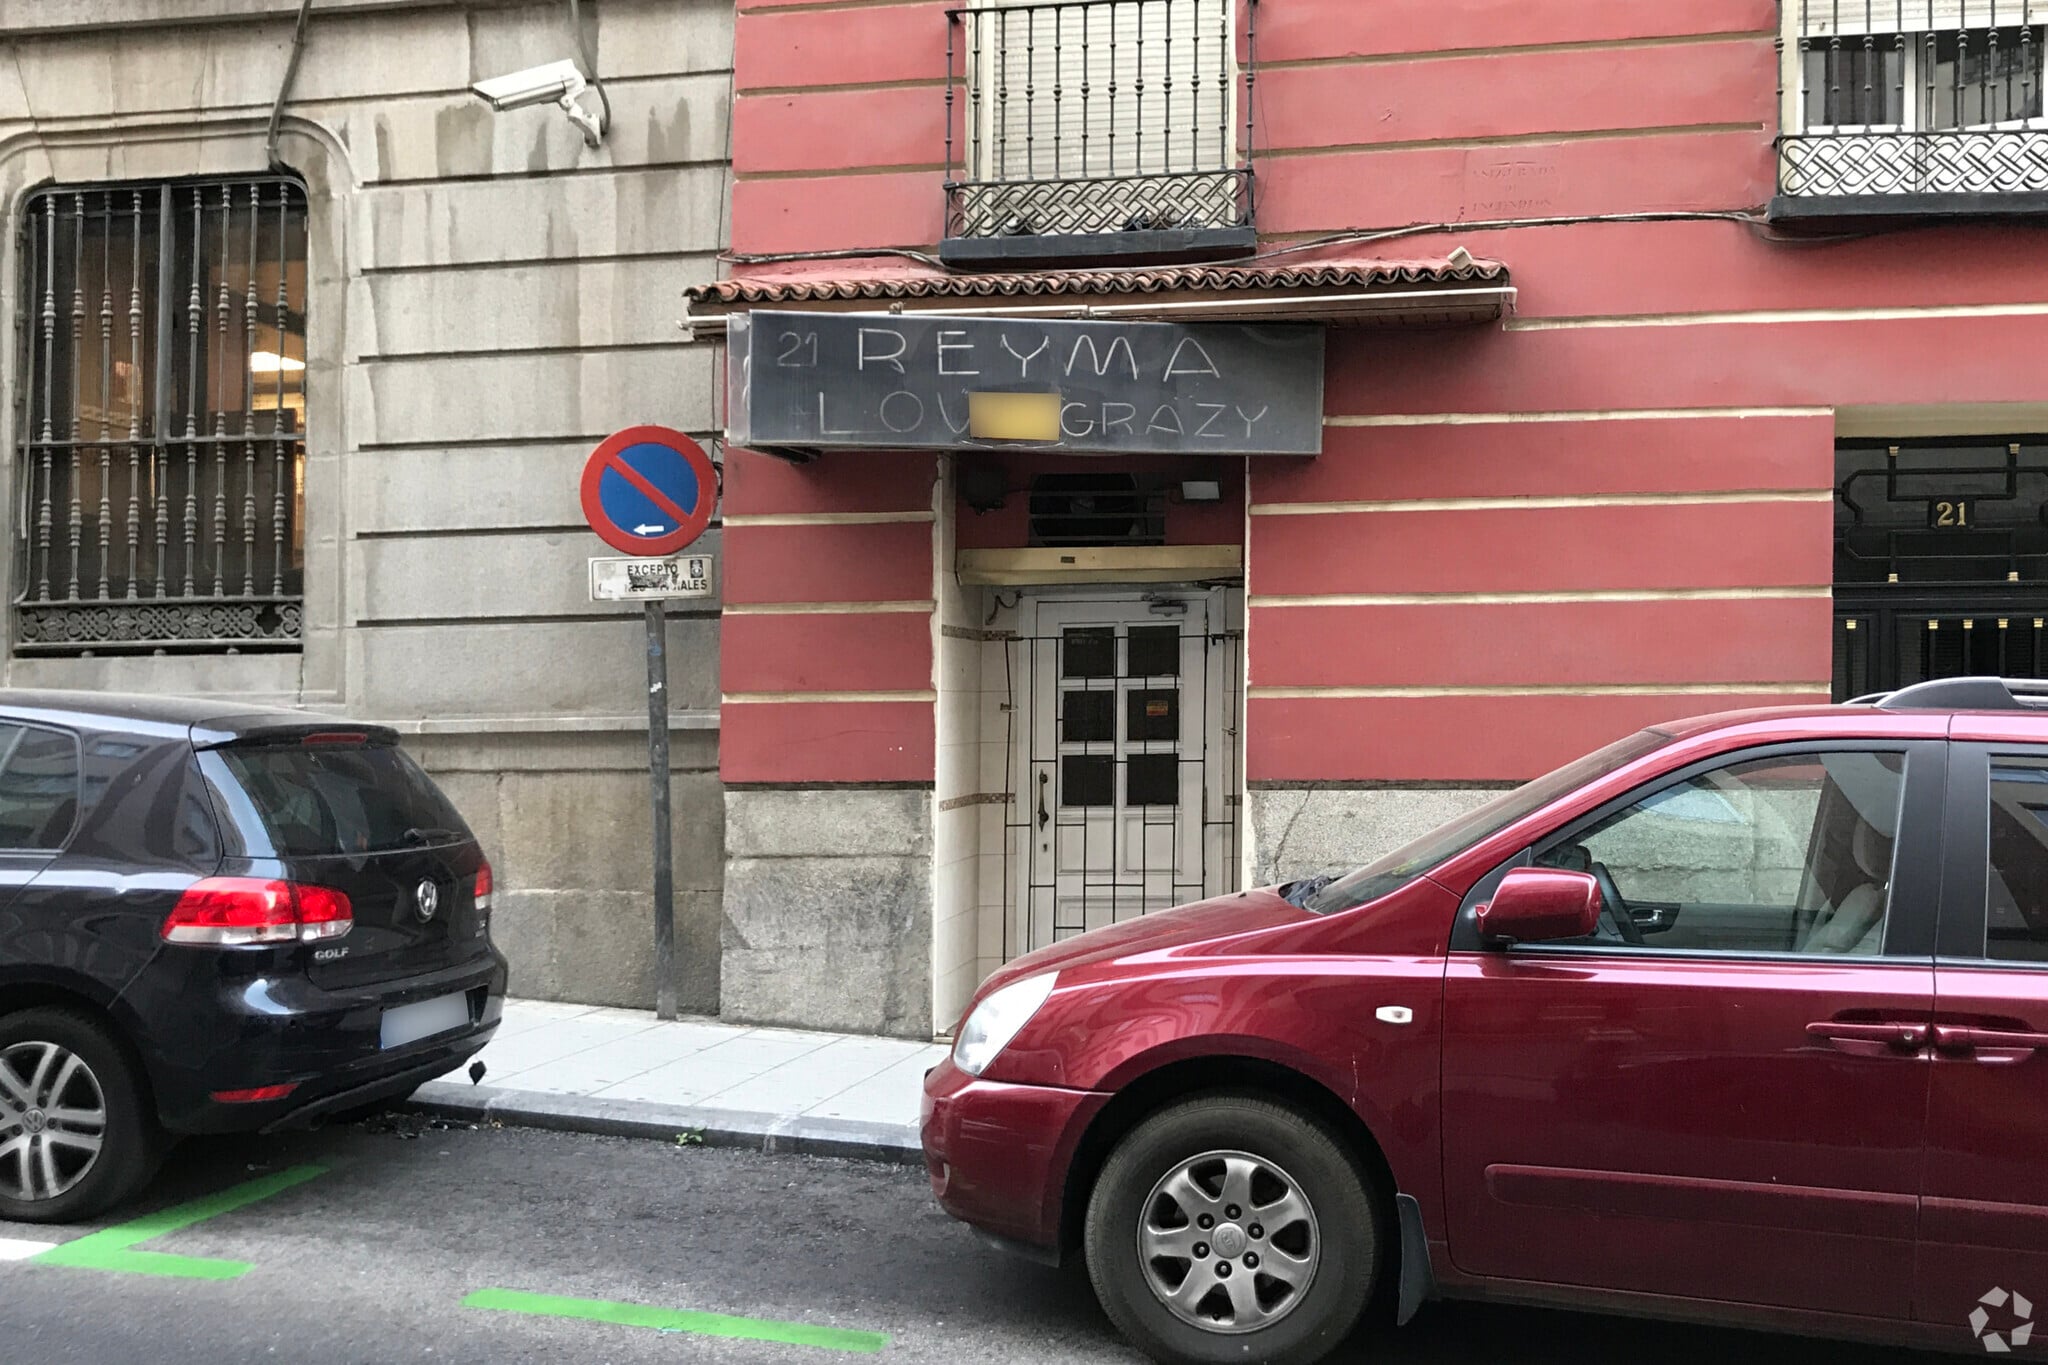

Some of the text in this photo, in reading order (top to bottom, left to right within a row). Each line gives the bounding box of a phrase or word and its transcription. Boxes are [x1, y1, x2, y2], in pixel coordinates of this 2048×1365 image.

[777, 327, 1221, 382] 21 REYMA
[1936, 501, 1967, 526] 21
[627, 563, 678, 576] EXCEPTO
[314, 946, 349, 959] GOLF
